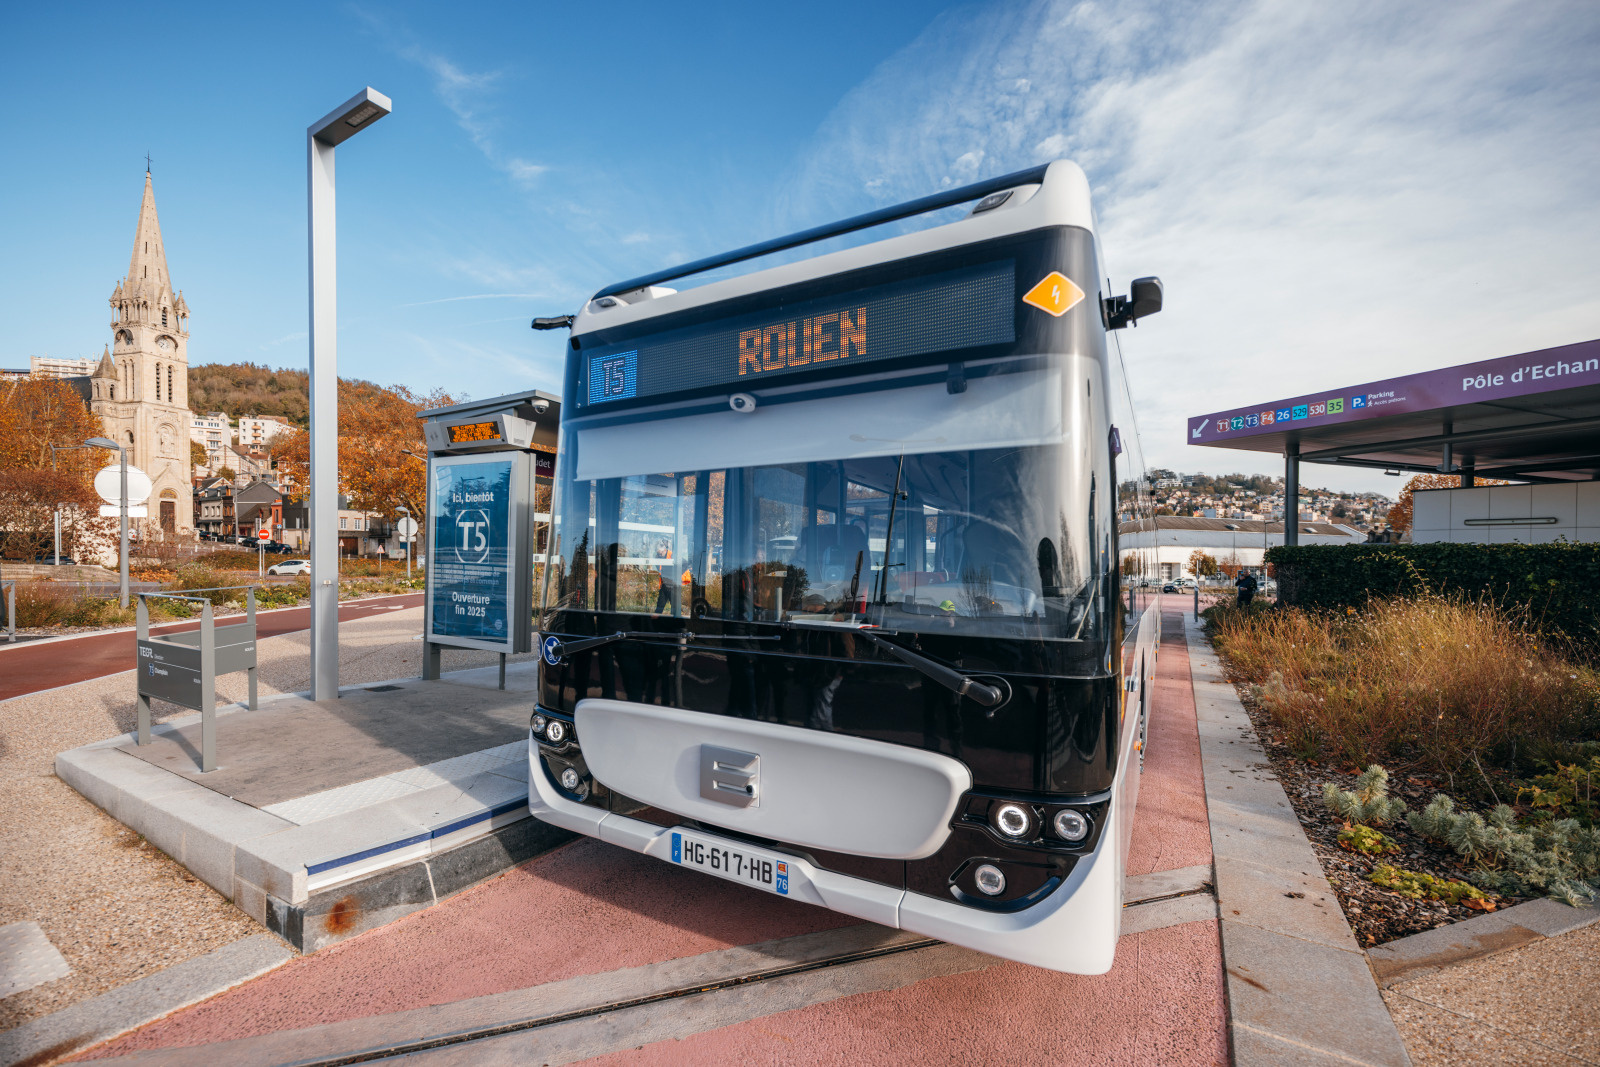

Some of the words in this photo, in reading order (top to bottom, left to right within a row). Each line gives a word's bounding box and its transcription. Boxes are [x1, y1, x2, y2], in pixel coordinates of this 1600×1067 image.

[738, 307, 867, 376] ROUEN
[603, 360, 625, 395] T5
[1462, 373, 1504, 391] Pôle
[1367, 391, 1395, 400] Parking
[1218, 421, 1229, 430] T1
[1232, 418, 1243, 428] T2
[1246, 416, 1258, 425] T3
[1261, 413, 1274, 422] F4
[1277, 410, 1290, 421] 26
[1293, 407, 1307, 418] 529
[1309, 404, 1325, 415] 530
[1328, 401, 1342, 412] 35
[452, 493, 464, 504] Ici,
[465, 491, 495, 503] bientôt
[458, 521, 487, 552] T5
[452, 591, 491, 605] Ouverture
[455, 604, 466, 615] fin
[467, 605, 486, 617] 2025
[777, 877, 788, 890] 76
